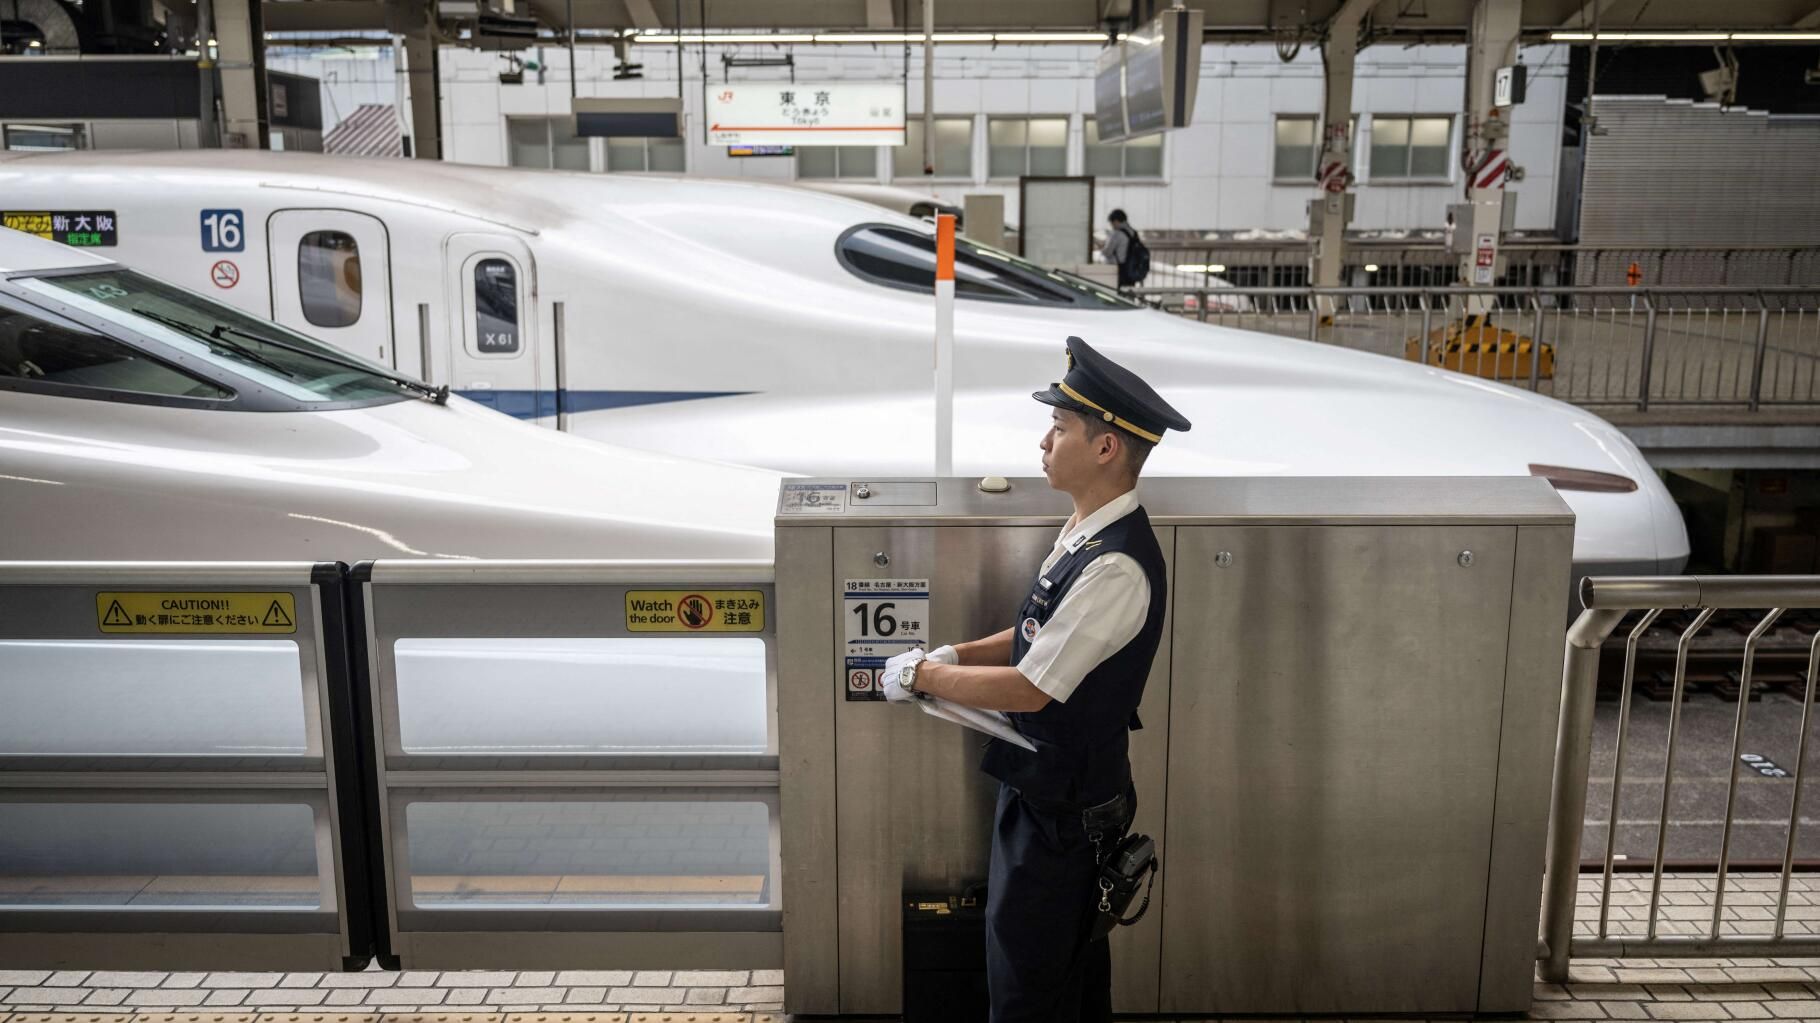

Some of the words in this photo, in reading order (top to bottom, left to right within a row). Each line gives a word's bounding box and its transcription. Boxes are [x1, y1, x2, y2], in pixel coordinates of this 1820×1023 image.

[1498, 75, 1510, 97] 17
[718, 90, 734, 101] JR
[779, 91, 830, 106] 東京
[782, 107, 829, 117] とうきょう
[53, 216, 114, 231] 新大阪
[204, 213, 240, 248] 16
[846, 582, 857, 591] 18
[161, 600, 230, 611] CAUTION!!
[630, 600, 673, 612] Watch
[715, 600, 760, 610] まき込み
[135, 614, 259, 626] 動く扉にご注意ください
[629, 613, 647, 624] the
[649, 613, 676, 624] door
[724, 612, 752, 625] 注意
[853, 602, 897, 637] 16
[900, 621, 921, 630] 号車
